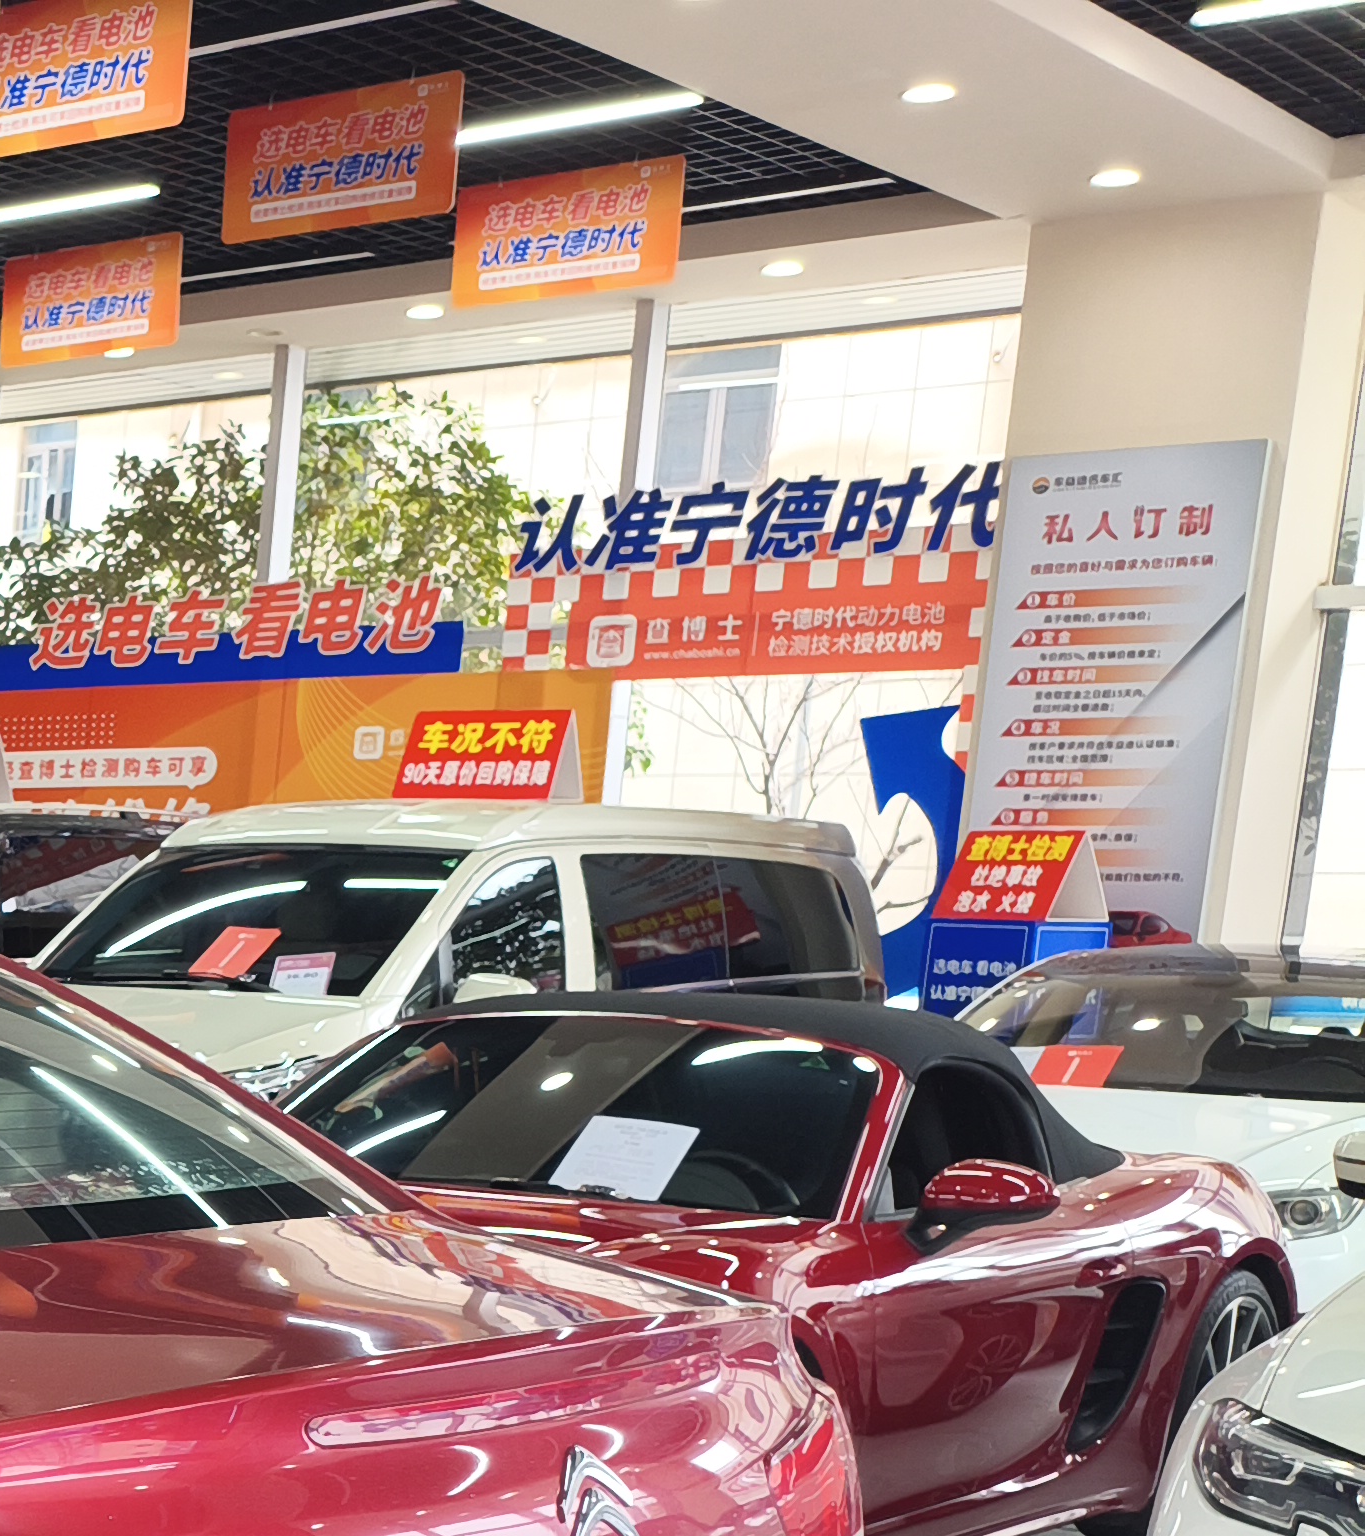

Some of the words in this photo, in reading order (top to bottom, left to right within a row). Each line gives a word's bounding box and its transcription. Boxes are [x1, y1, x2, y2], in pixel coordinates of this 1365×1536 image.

[67, 3, 157, 57] 看电池
[253, 116, 340, 162] 选电车
[341, 101, 428, 149] 看电池
[250, 143, 424, 199] 认准宁德时代
[482, 194, 566, 236] 选电车
[566, 182, 651, 223] 看电池
[477, 219, 647, 270] 认准宁德时代
[24, 267, 89, 302] 选电车
[90, 257, 156, 292] 看电池
[20, 289, 155, 333] 认准宁德时代
[513, 461, 1002, 573] 认准宁德时代
[1042, 503, 1214, 545] 私人订制
[29, 589, 225, 671] 选电车
[232, 572, 443, 660] 看电池
[645, 614, 743, 644] 查博士
[771, 601, 946, 631] 宁德时代动力电池
[768, 630, 942, 658] 检测技术授权机构
[418, 719, 556, 754] 车况不符
[402, 760, 551, 786] 90天原价回购保障
[966, 834, 1074, 861] 查博士检测
[971, 865, 1043, 888] 杜绝事故
[953, 890, 991, 913] 泡水
[996, 890, 1035, 914] 火烧
